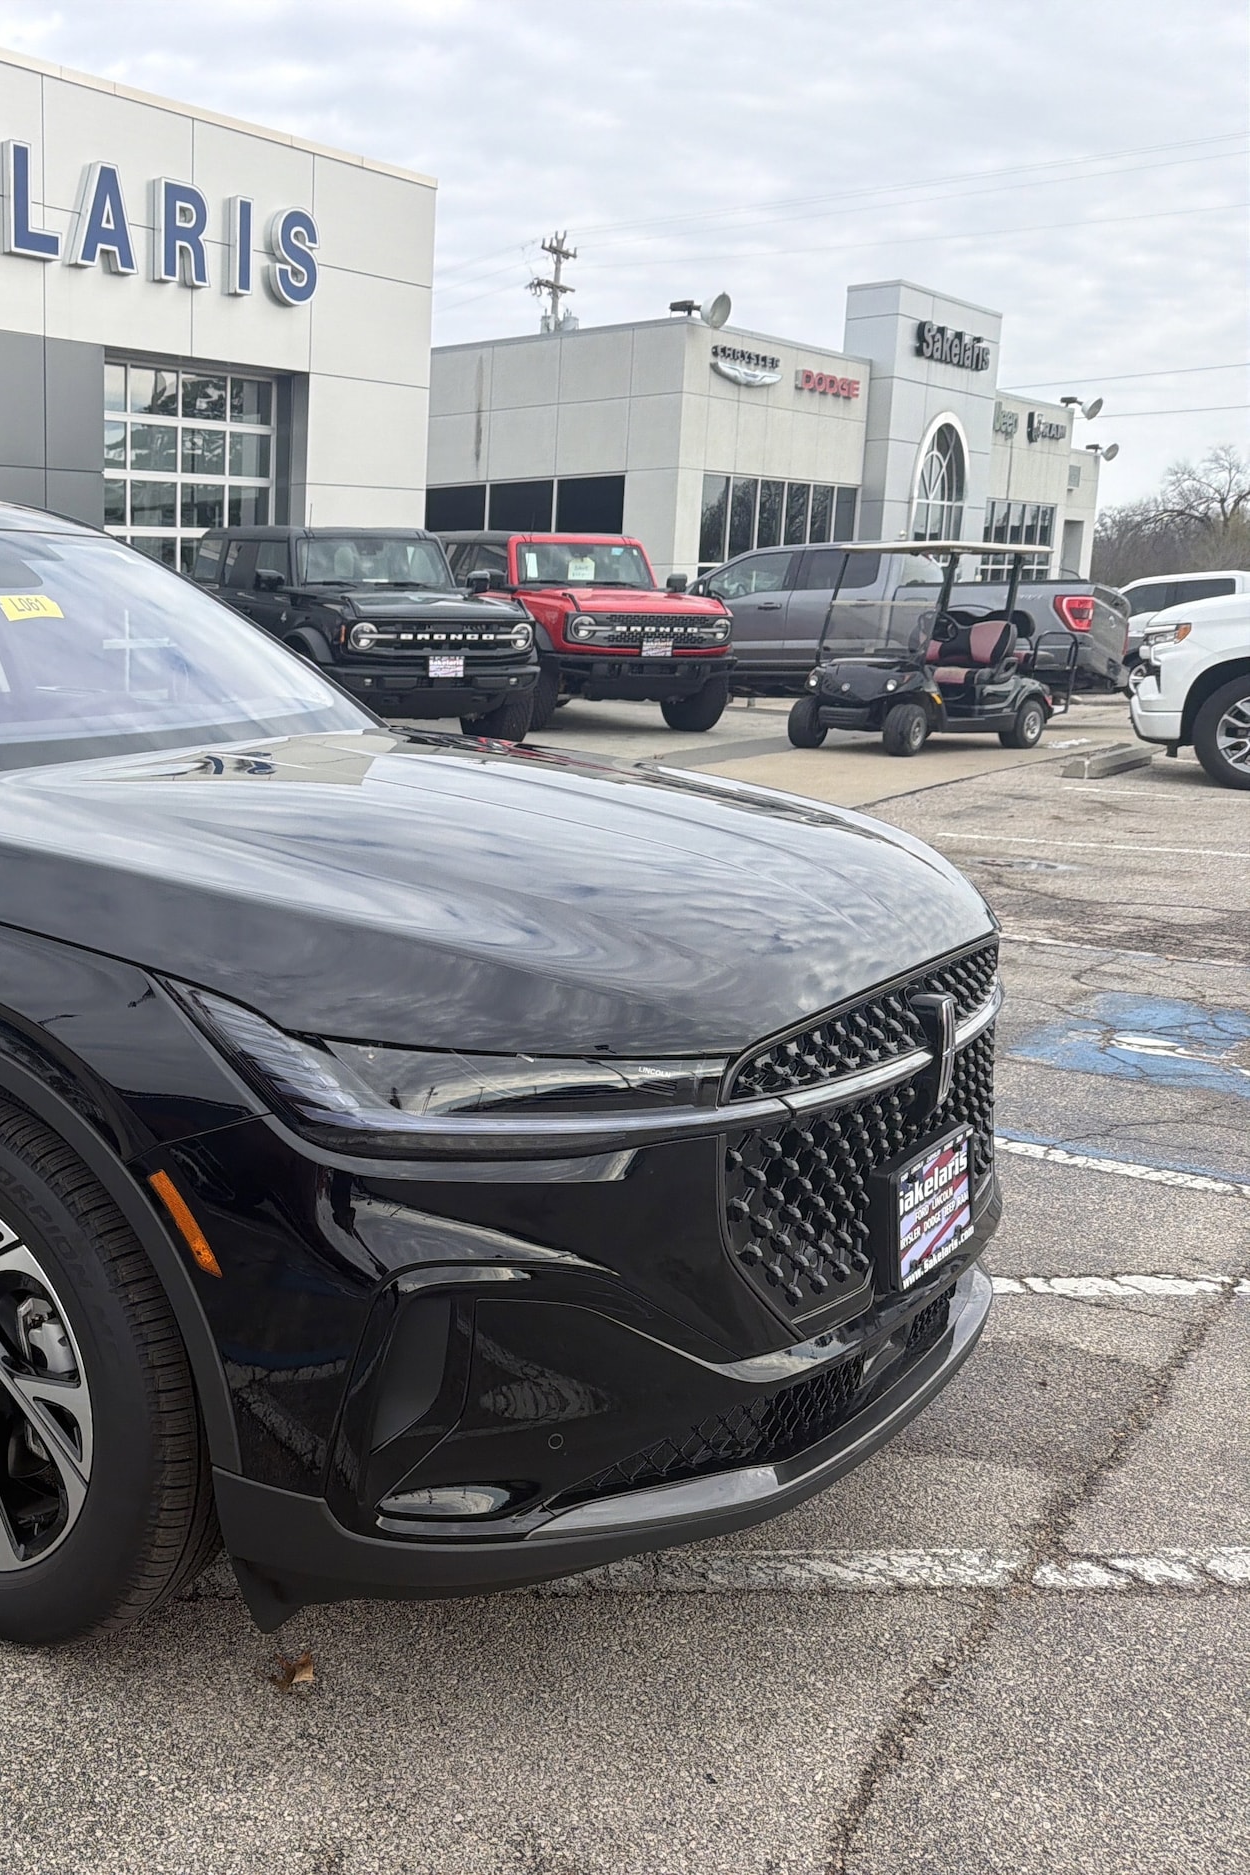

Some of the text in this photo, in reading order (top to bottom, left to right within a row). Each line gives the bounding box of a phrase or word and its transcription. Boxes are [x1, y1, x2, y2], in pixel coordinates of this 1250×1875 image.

[917, 321, 990, 371] Sakelaris
[798, 369, 861, 398] DODGE
[8, 597, 47, 612] L061
[615, 625, 698, 633] BRONCO
[638, 1066, 671, 1079] LINCOLN
[915, 1186, 954, 1222] FORD LINCOLN
[923, 1210, 942, 1231] DODGE
[943, 1200, 956, 1217] JEEP
[902, 1225, 974, 1290] www.Sakelaris.com
